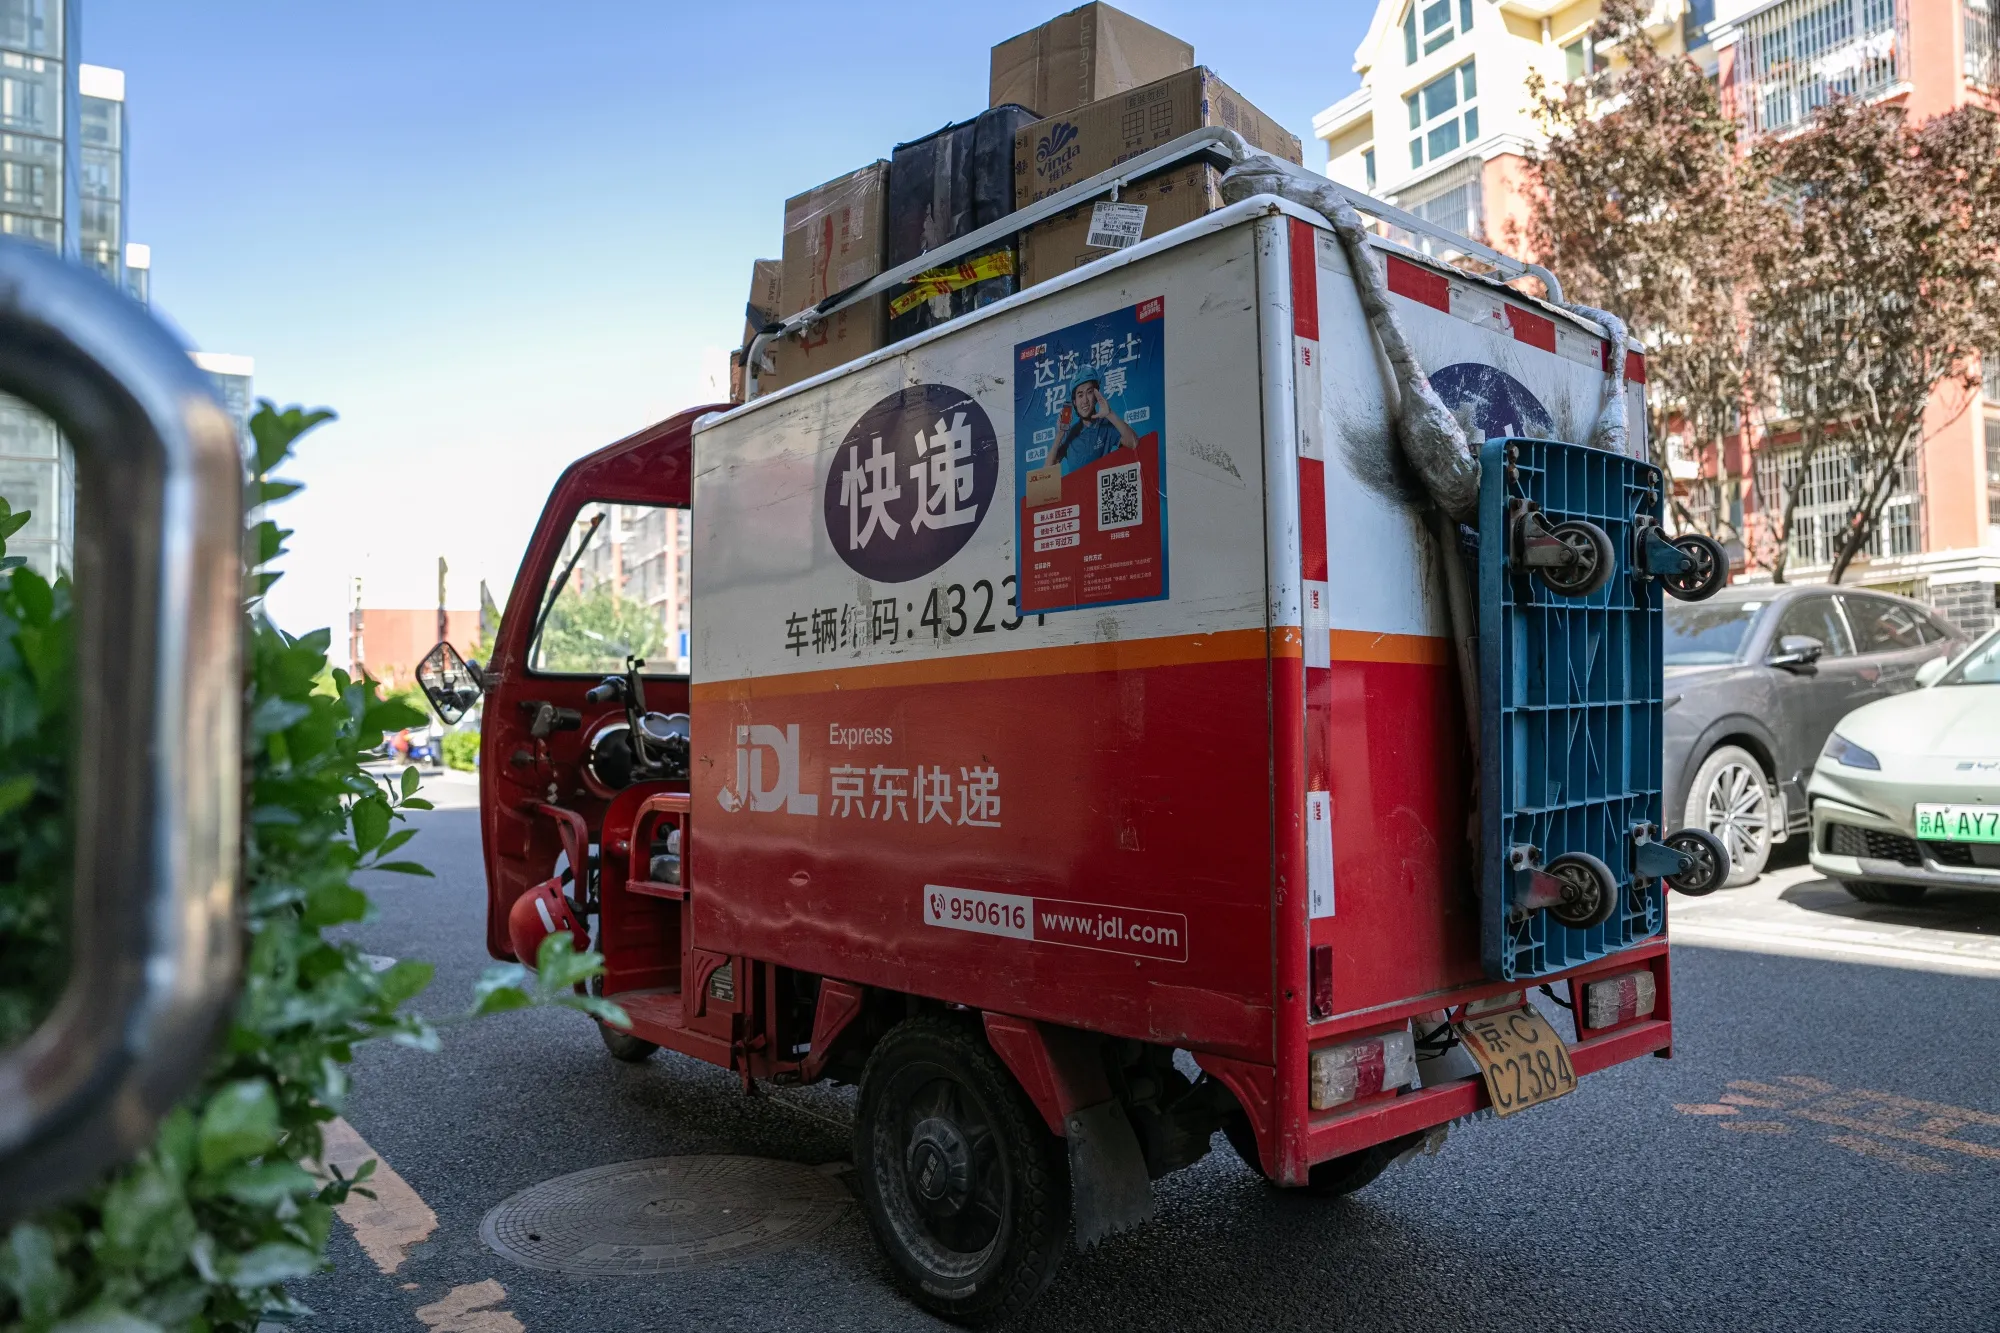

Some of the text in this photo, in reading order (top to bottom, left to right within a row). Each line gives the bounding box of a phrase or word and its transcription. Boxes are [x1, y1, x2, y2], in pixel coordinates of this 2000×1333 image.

[1049, 162, 1074, 184] 维达
[839, 411, 980, 551] 快递
[829, 723, 893, 751] Express
[829, 764, 1001, 828] 京东快递
[949, 898, 1179, 948] 950616 www.jdl.com
[1489, 1044, 1573, 1109] C2384
